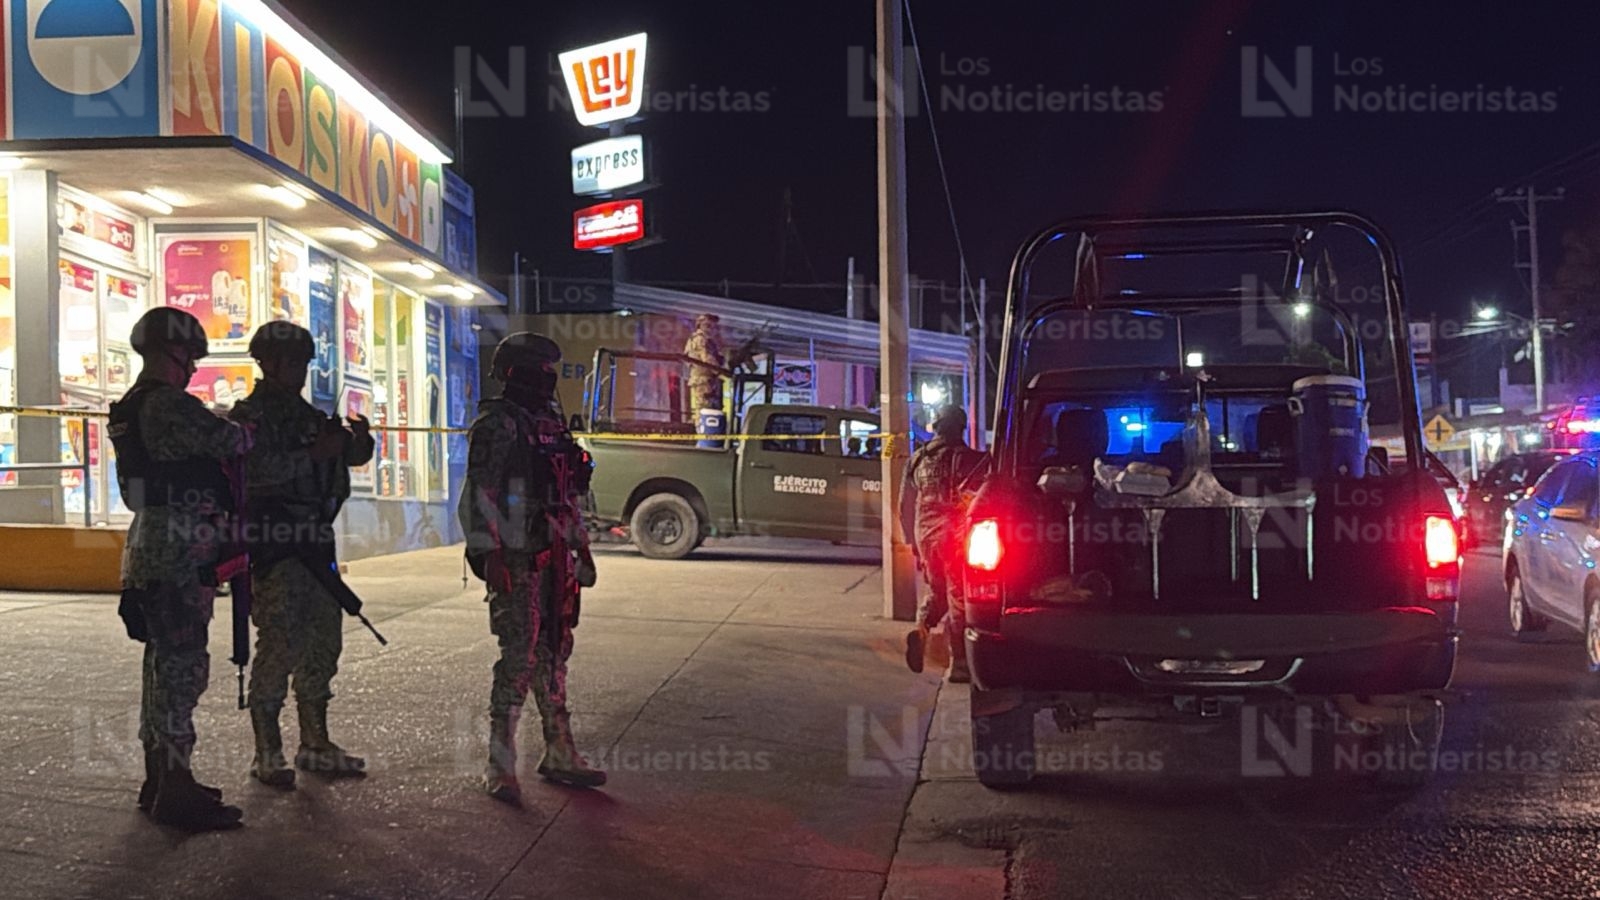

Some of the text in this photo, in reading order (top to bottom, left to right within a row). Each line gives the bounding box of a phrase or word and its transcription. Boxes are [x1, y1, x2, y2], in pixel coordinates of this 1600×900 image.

[172, 0, 396, 227] KIOSKO
[577, 149, 638, 178] express
[774, 475, 827, 488] EJÉRCITO
[862, 480, 882, 492] 080
[774, 485, 826, 495] MEXICANO
